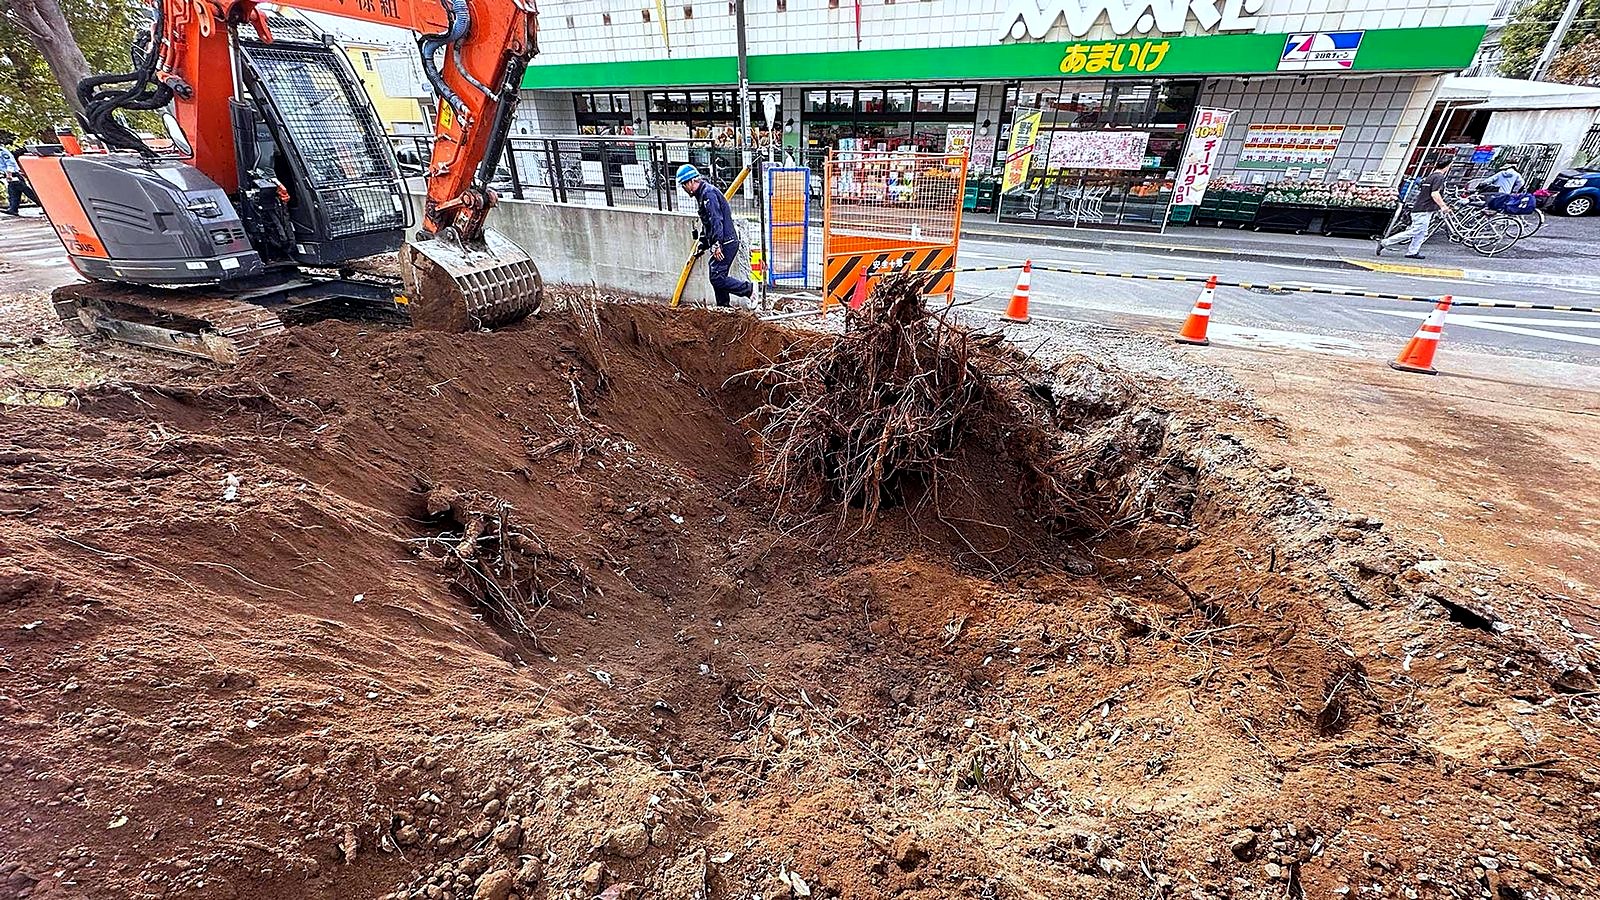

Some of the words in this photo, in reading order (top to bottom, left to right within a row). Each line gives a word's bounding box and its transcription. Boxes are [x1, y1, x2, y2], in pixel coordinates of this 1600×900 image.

[1060, 42, 1169, 73] あまいけ
[1198, 139, 1217, 176] チーズ
[1175, 185, 1185, 204] の日
[1185, 162, 1199, 197] バター
